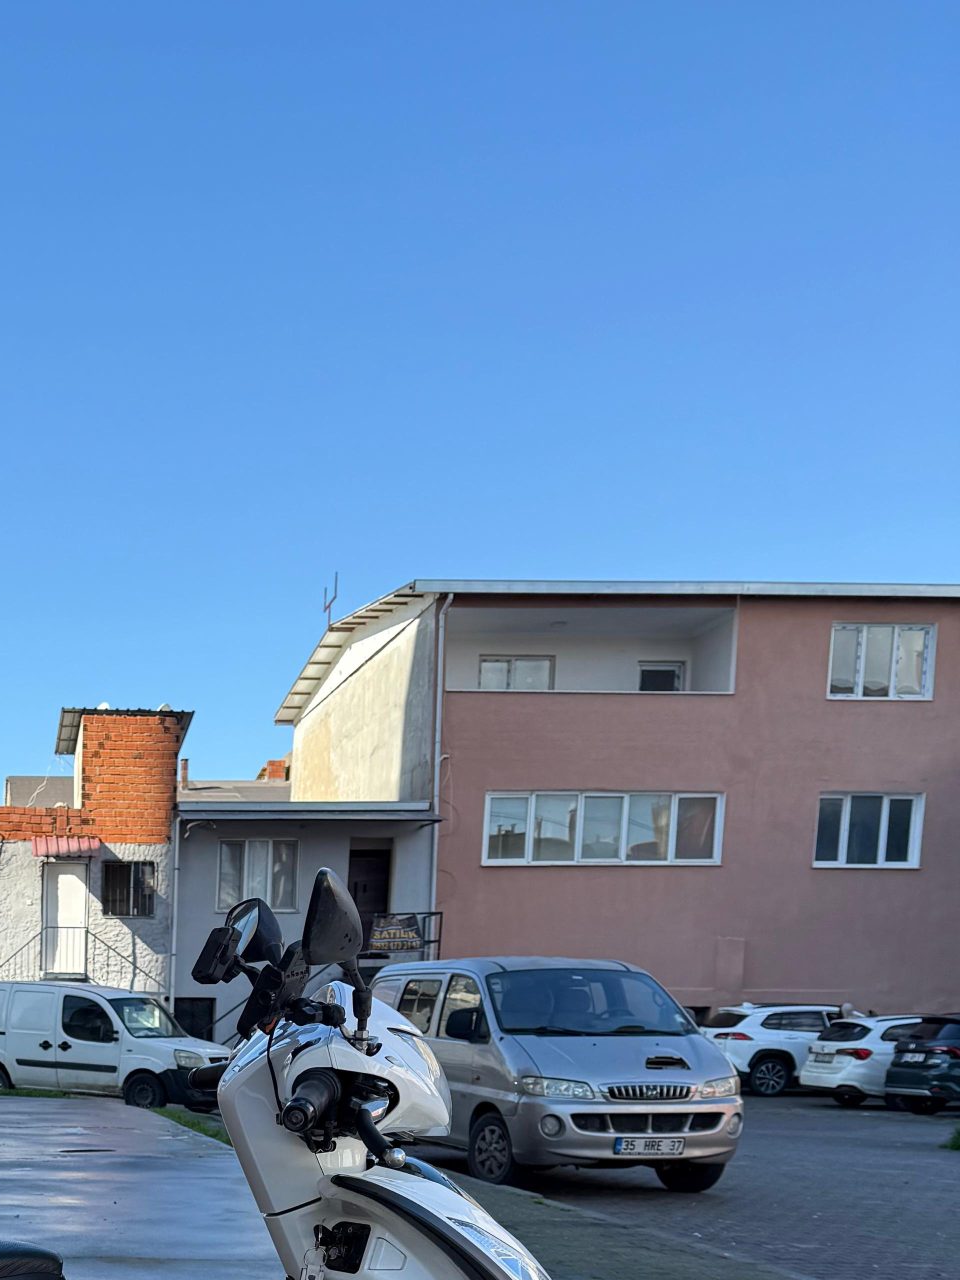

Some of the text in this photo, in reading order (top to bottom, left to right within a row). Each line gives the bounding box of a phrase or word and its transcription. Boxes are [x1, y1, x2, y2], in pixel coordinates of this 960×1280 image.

[623, 1140, 683, 1151] 35 HRE 37
